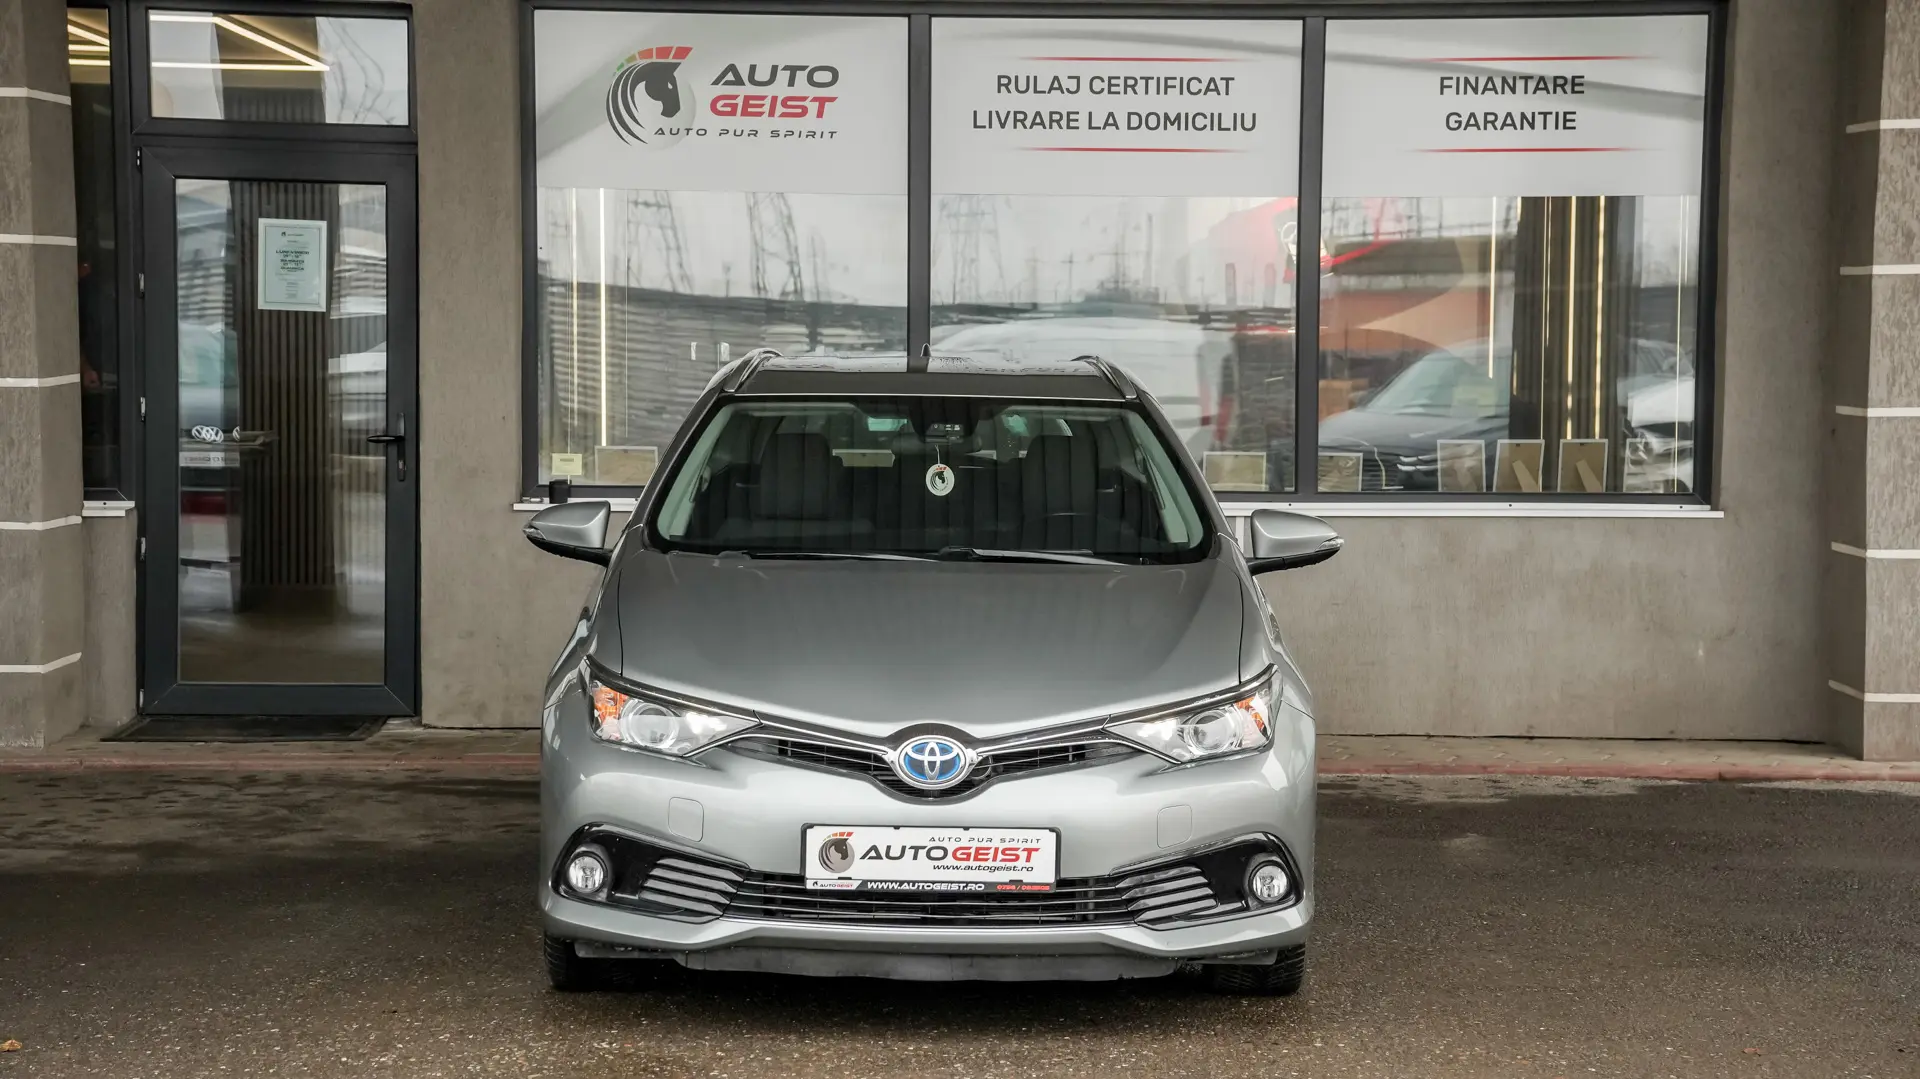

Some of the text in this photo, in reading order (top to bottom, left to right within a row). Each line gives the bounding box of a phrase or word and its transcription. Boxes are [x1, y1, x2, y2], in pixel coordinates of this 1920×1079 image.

[710, 63, 839, 88] AUTO
[996, 75, 1236, 97] RULAJ CERTIFICAT
[1439, 75, 1585, 96] FINANTARE
[709, 94, 839, 119] GEIST
[972, 109, 1257, 132] LIVRARE LA DOMICILIU
[1445, 111, 1577, 132] GARANTIE
[653, 127, 838, 140] AUTO PUR SPIRIT
[999, 837, 1042, 845] SPIRIT
[859, 844, 1041, 863] AUTOGEIST
[932, 864, 1034, 873] www.autogeist.ro
[866, 881, 985, 891] WWW.AUTOGEIST.RO
